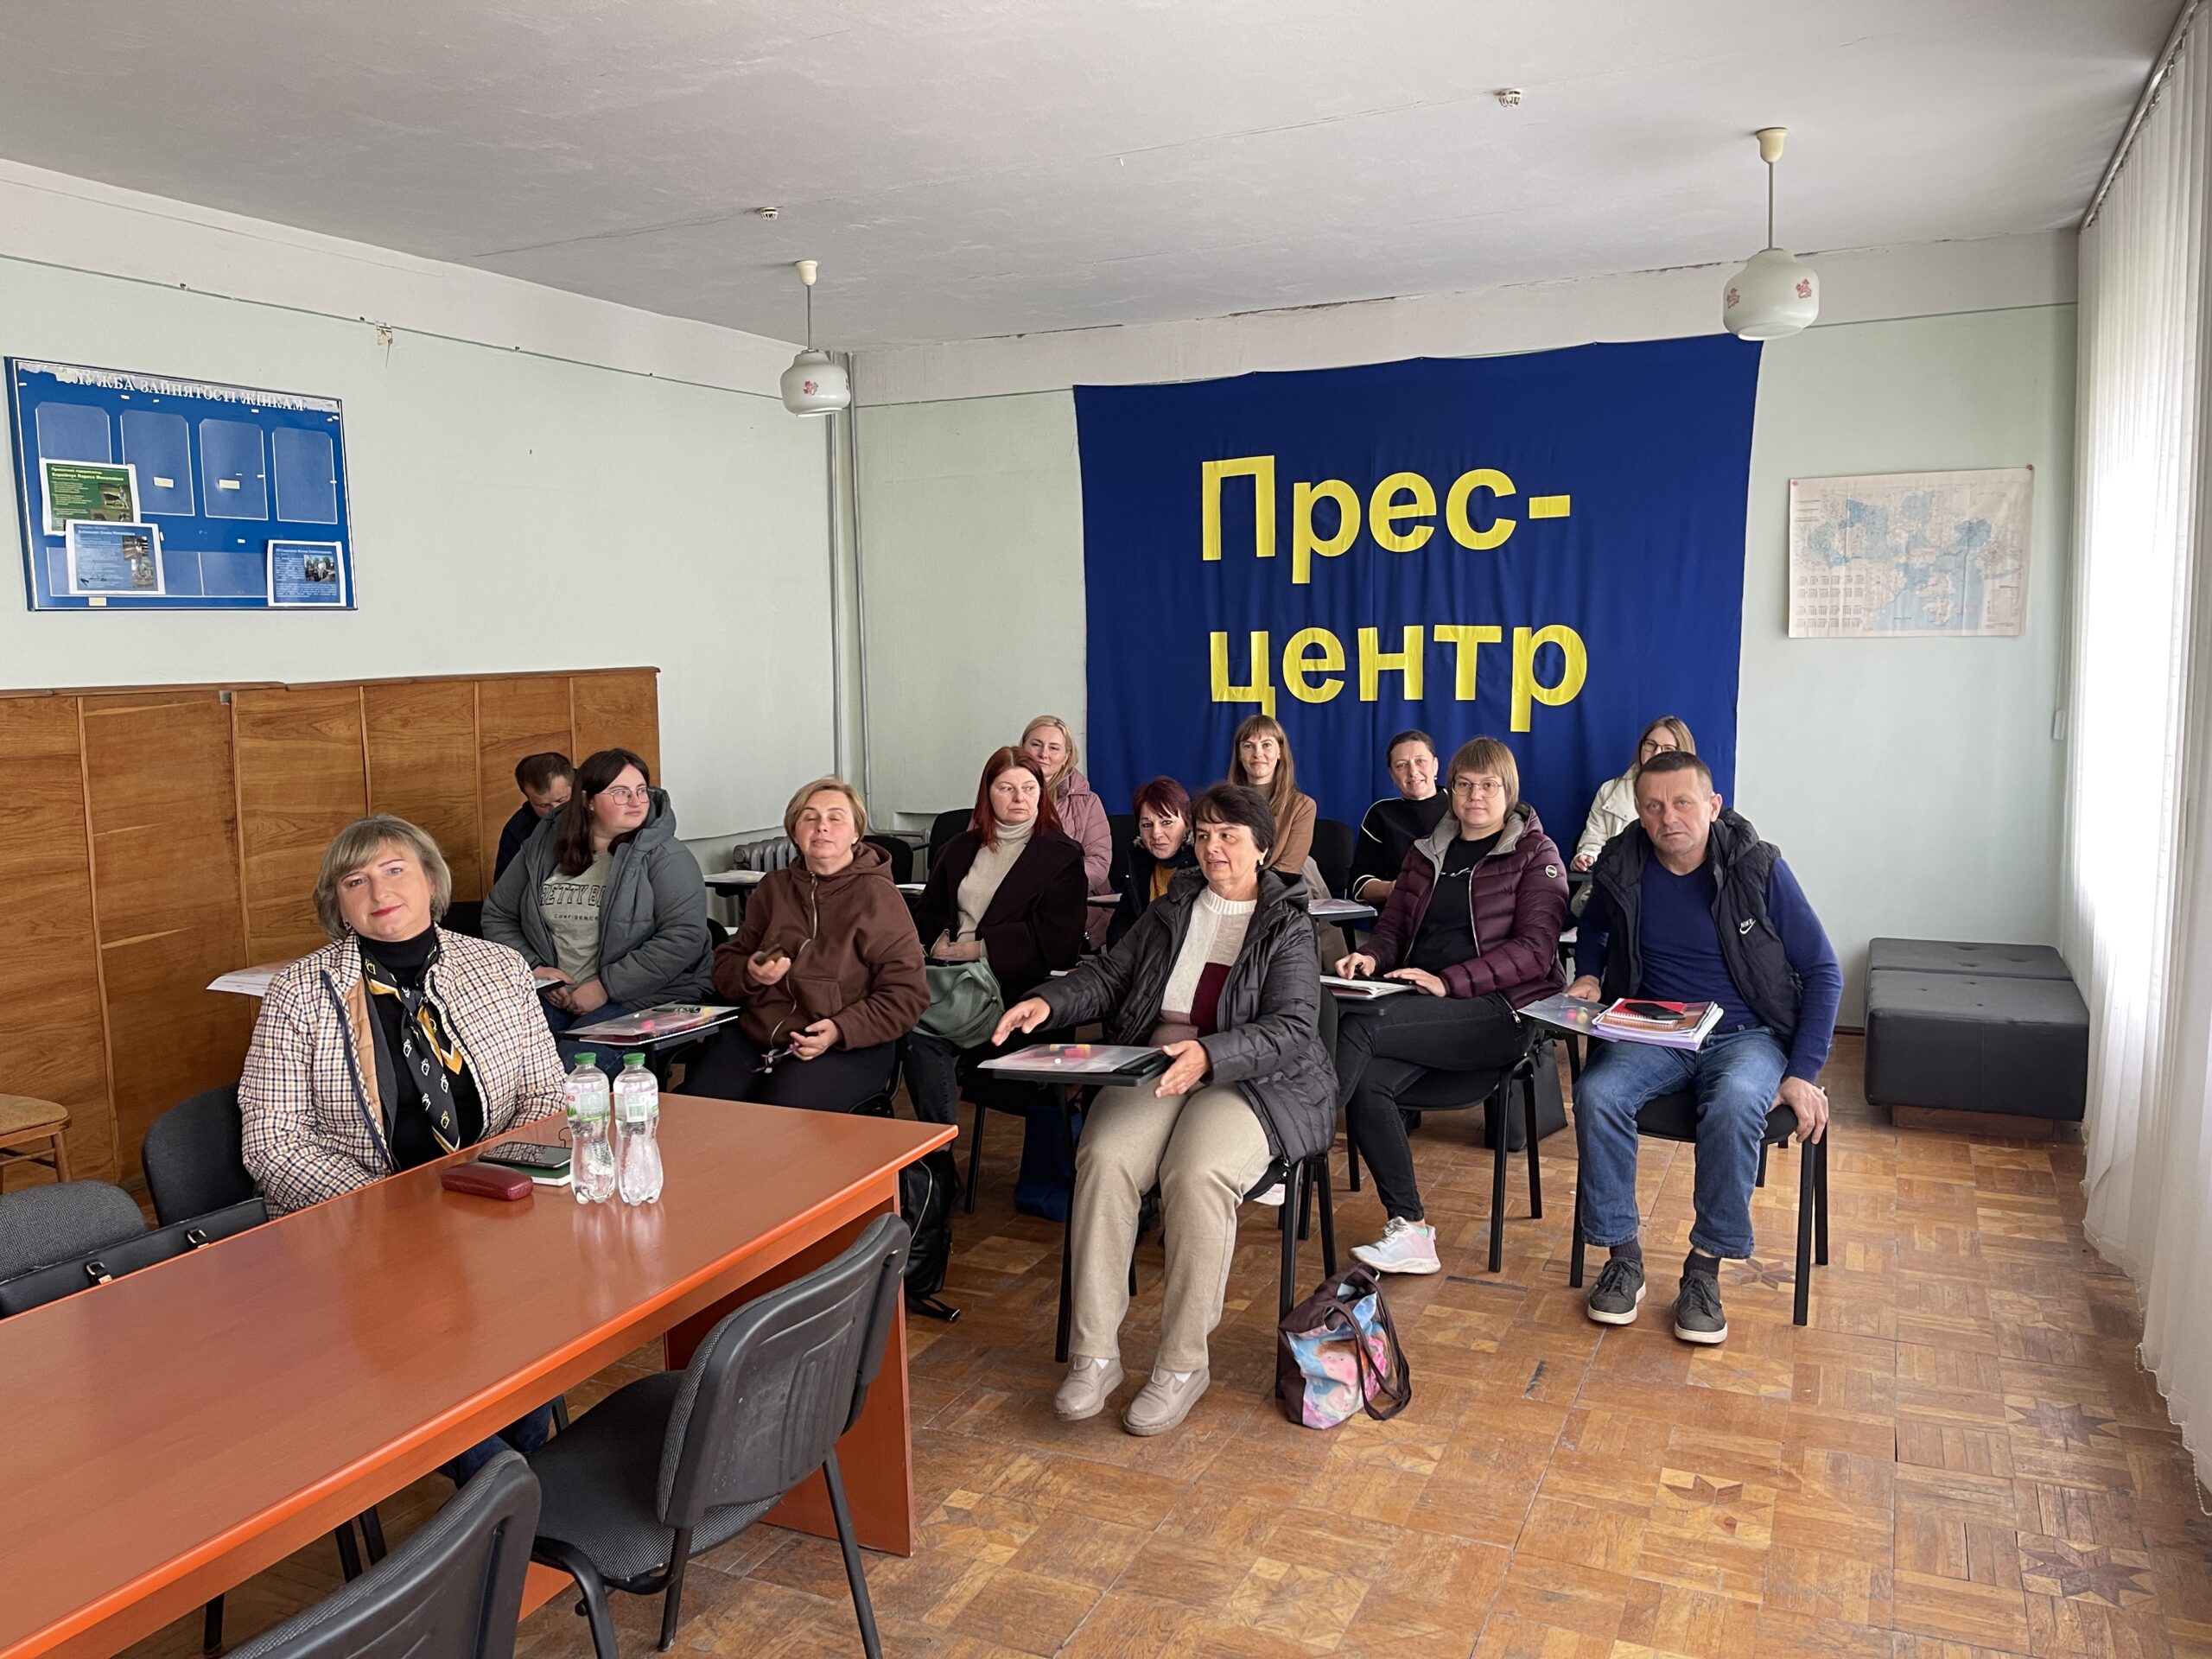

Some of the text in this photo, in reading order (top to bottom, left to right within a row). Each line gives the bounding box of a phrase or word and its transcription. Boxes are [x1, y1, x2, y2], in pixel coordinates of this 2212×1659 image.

[66, 369, 305, 411] ЛУЖБА ЗАЙНЯТОСТІ ЖІНКАМ
[1202, 454, 1570, 584] Прес-
[1210, 624, 1587, 733] центр
[1740, 918, 1754, 929] NIKE
